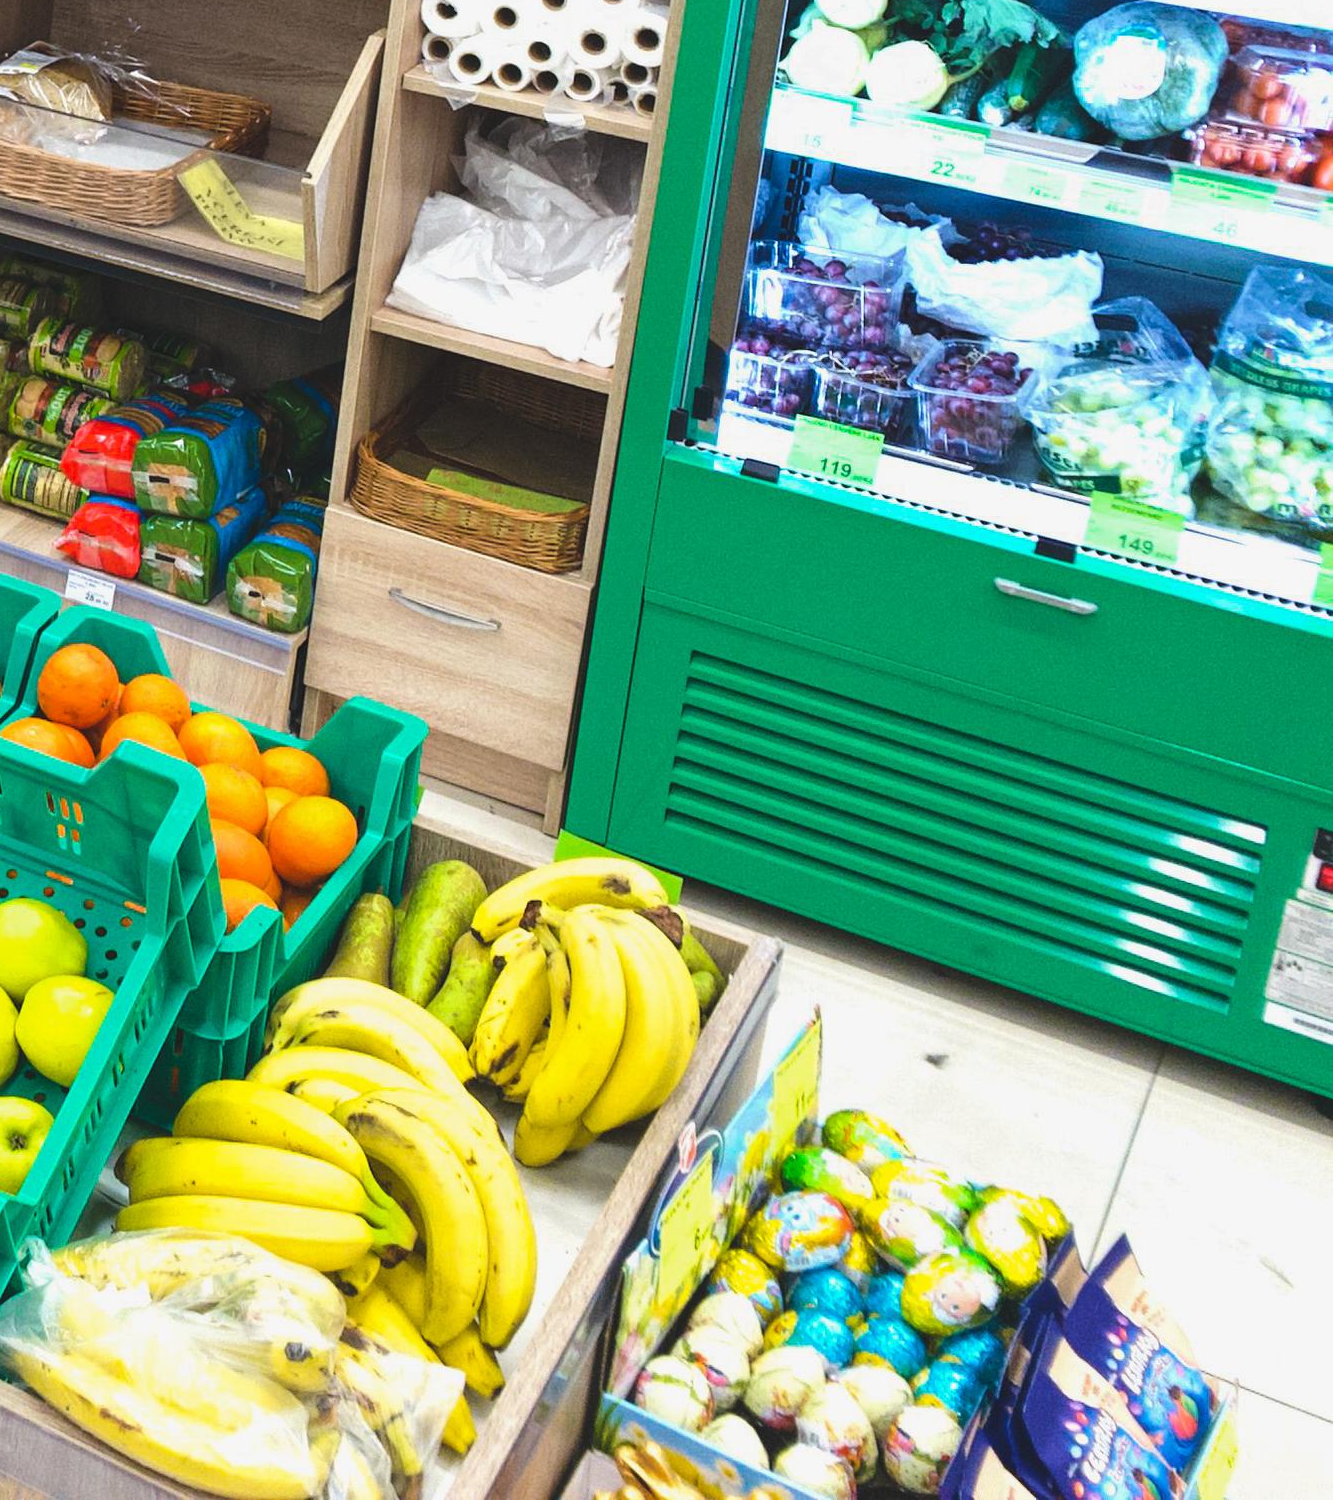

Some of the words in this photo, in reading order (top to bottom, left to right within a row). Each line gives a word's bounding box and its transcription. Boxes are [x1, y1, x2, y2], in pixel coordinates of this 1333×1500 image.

[930, 160, 957, 178] 22
[819, 457, 852, 478] 119
[1118, 534, 1154, 556] 149
